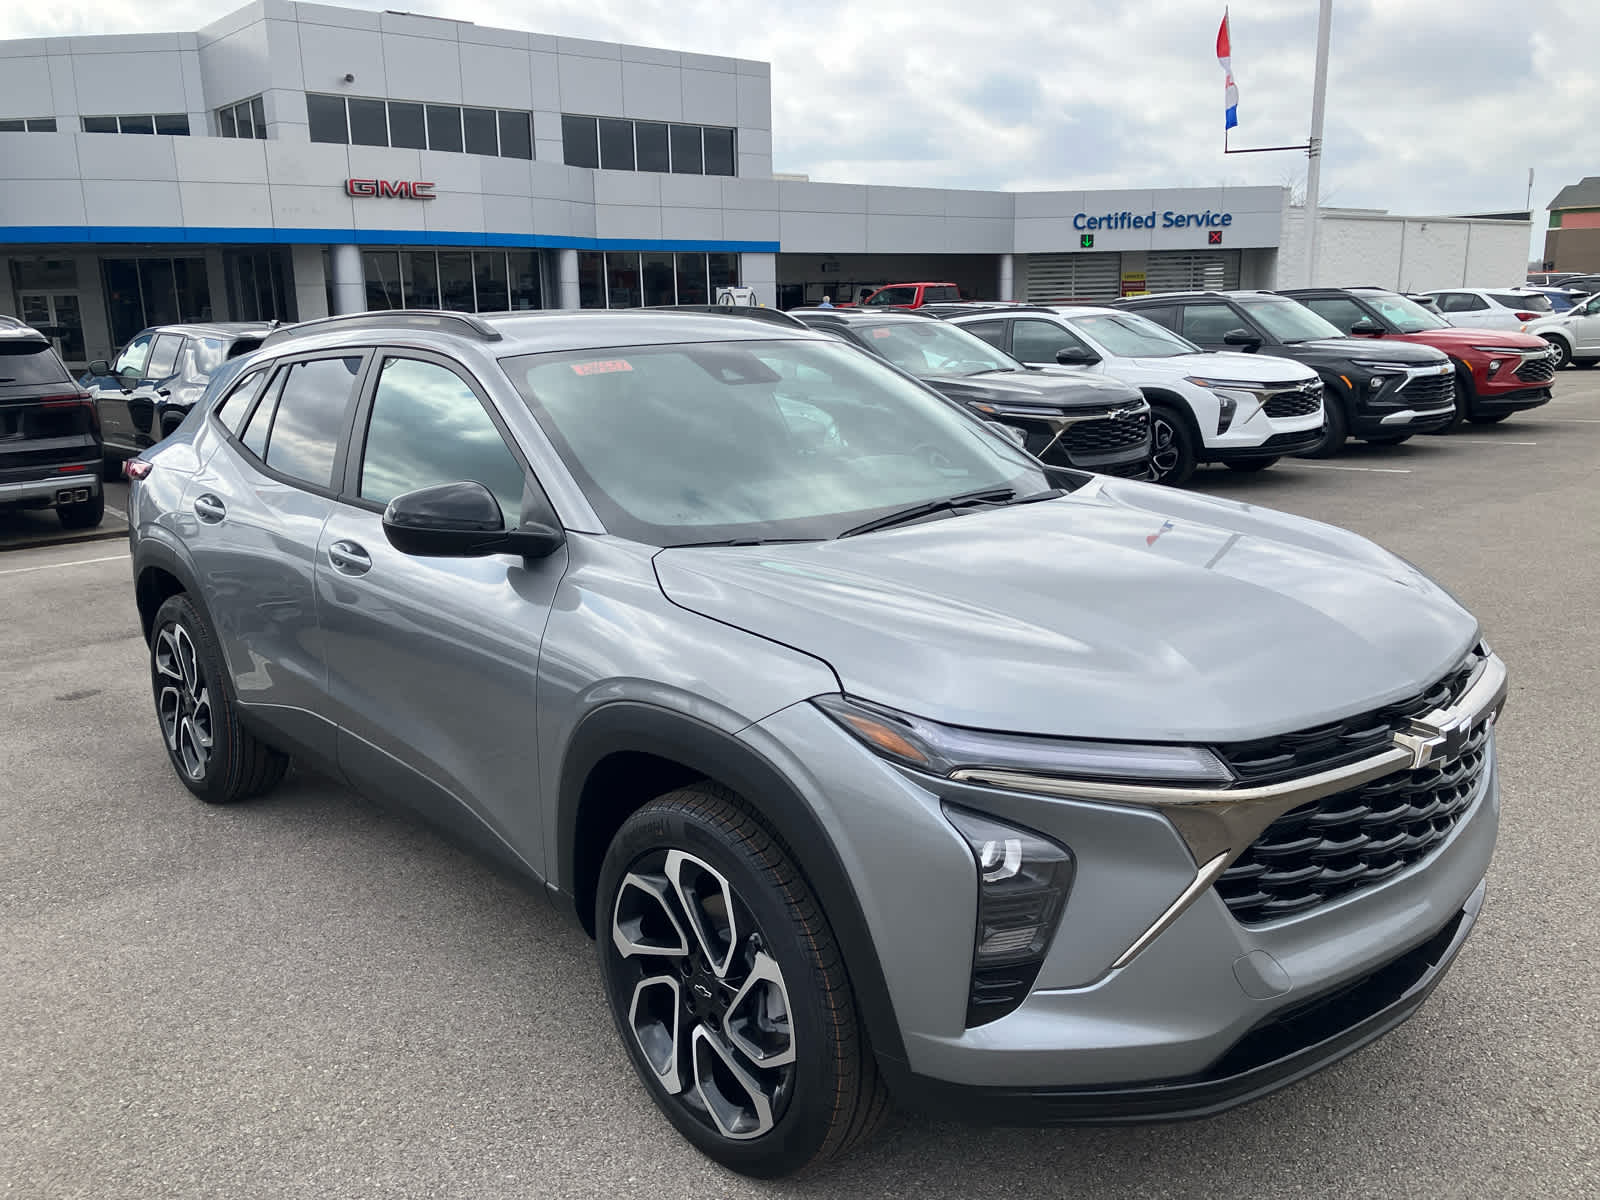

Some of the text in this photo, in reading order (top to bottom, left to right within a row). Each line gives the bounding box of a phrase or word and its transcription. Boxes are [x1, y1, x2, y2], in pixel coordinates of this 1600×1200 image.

[345, 178, 437, 199] GMC
[1073, 210, 1232, 230] Certified Service
